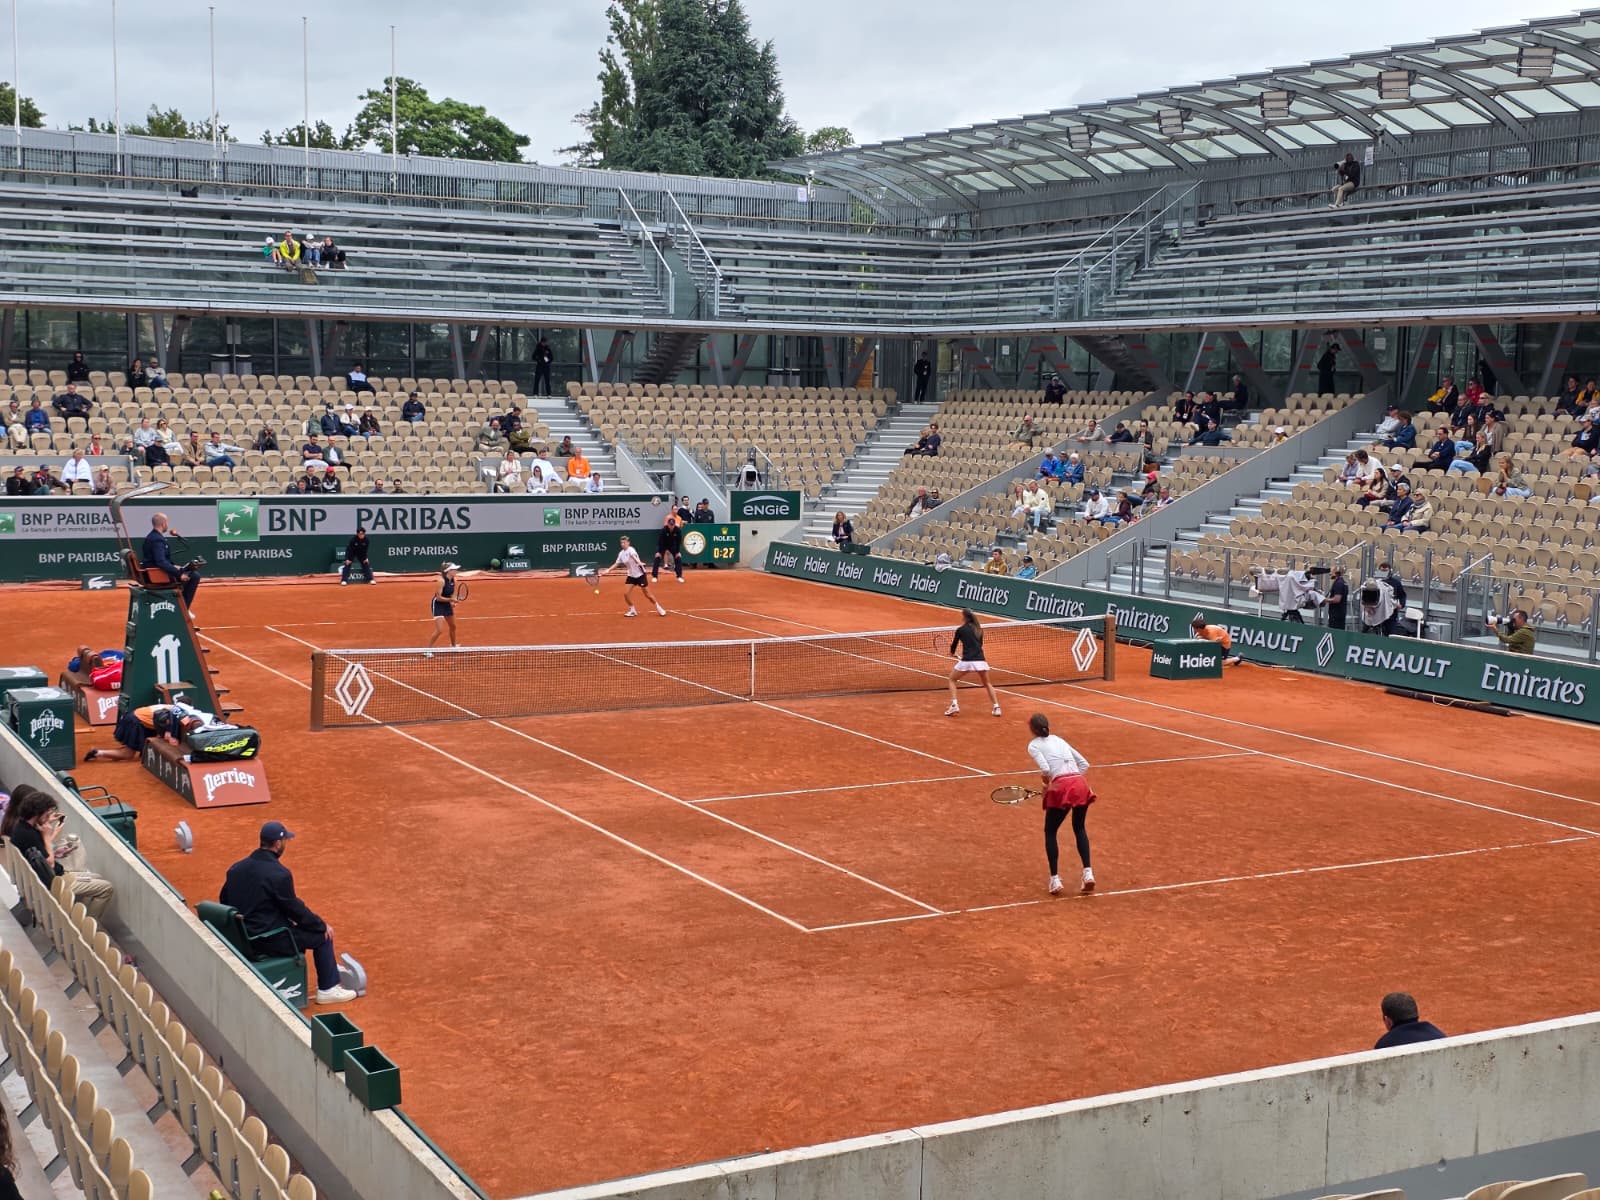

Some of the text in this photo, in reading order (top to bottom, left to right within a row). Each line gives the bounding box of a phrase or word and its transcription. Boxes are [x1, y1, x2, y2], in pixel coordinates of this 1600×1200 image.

[22, 513, 117, 526] BNP PARIBA
[268, 507, 471, 532] BNP PARIBAS
[565, 507, 641, 519] BNP PARIBAS
[216, 548, 293, 560] BNP PARIBAS
[388, 545, 458, 556] BNP PARIBAS
[542, 542, 607, 553] BNP PARIBAS
[713, 547, 735, 559] 0:27
[39, 551, 121, 564] BNP PARIBAS
[773, 551, 798, 569] Haier
[804, 556, 829, 574] Haier
[836, 561, 864, 580] Haier
[873, 567, 902, 587] Haier
[909, 573, 941, 594] Haier
[956, 579, 1010, 606] Emirates
[1025, 590, 1085, 617] Emirates
[1106, 602, 1170, 633] Emirates
[1153, 653, 1172, 665] Haier
[1179, 653, 1216, 669] Haier
[1345, 645, 1451, 679] RENAULT
[1481, 663, 1587, 705] Emirates
